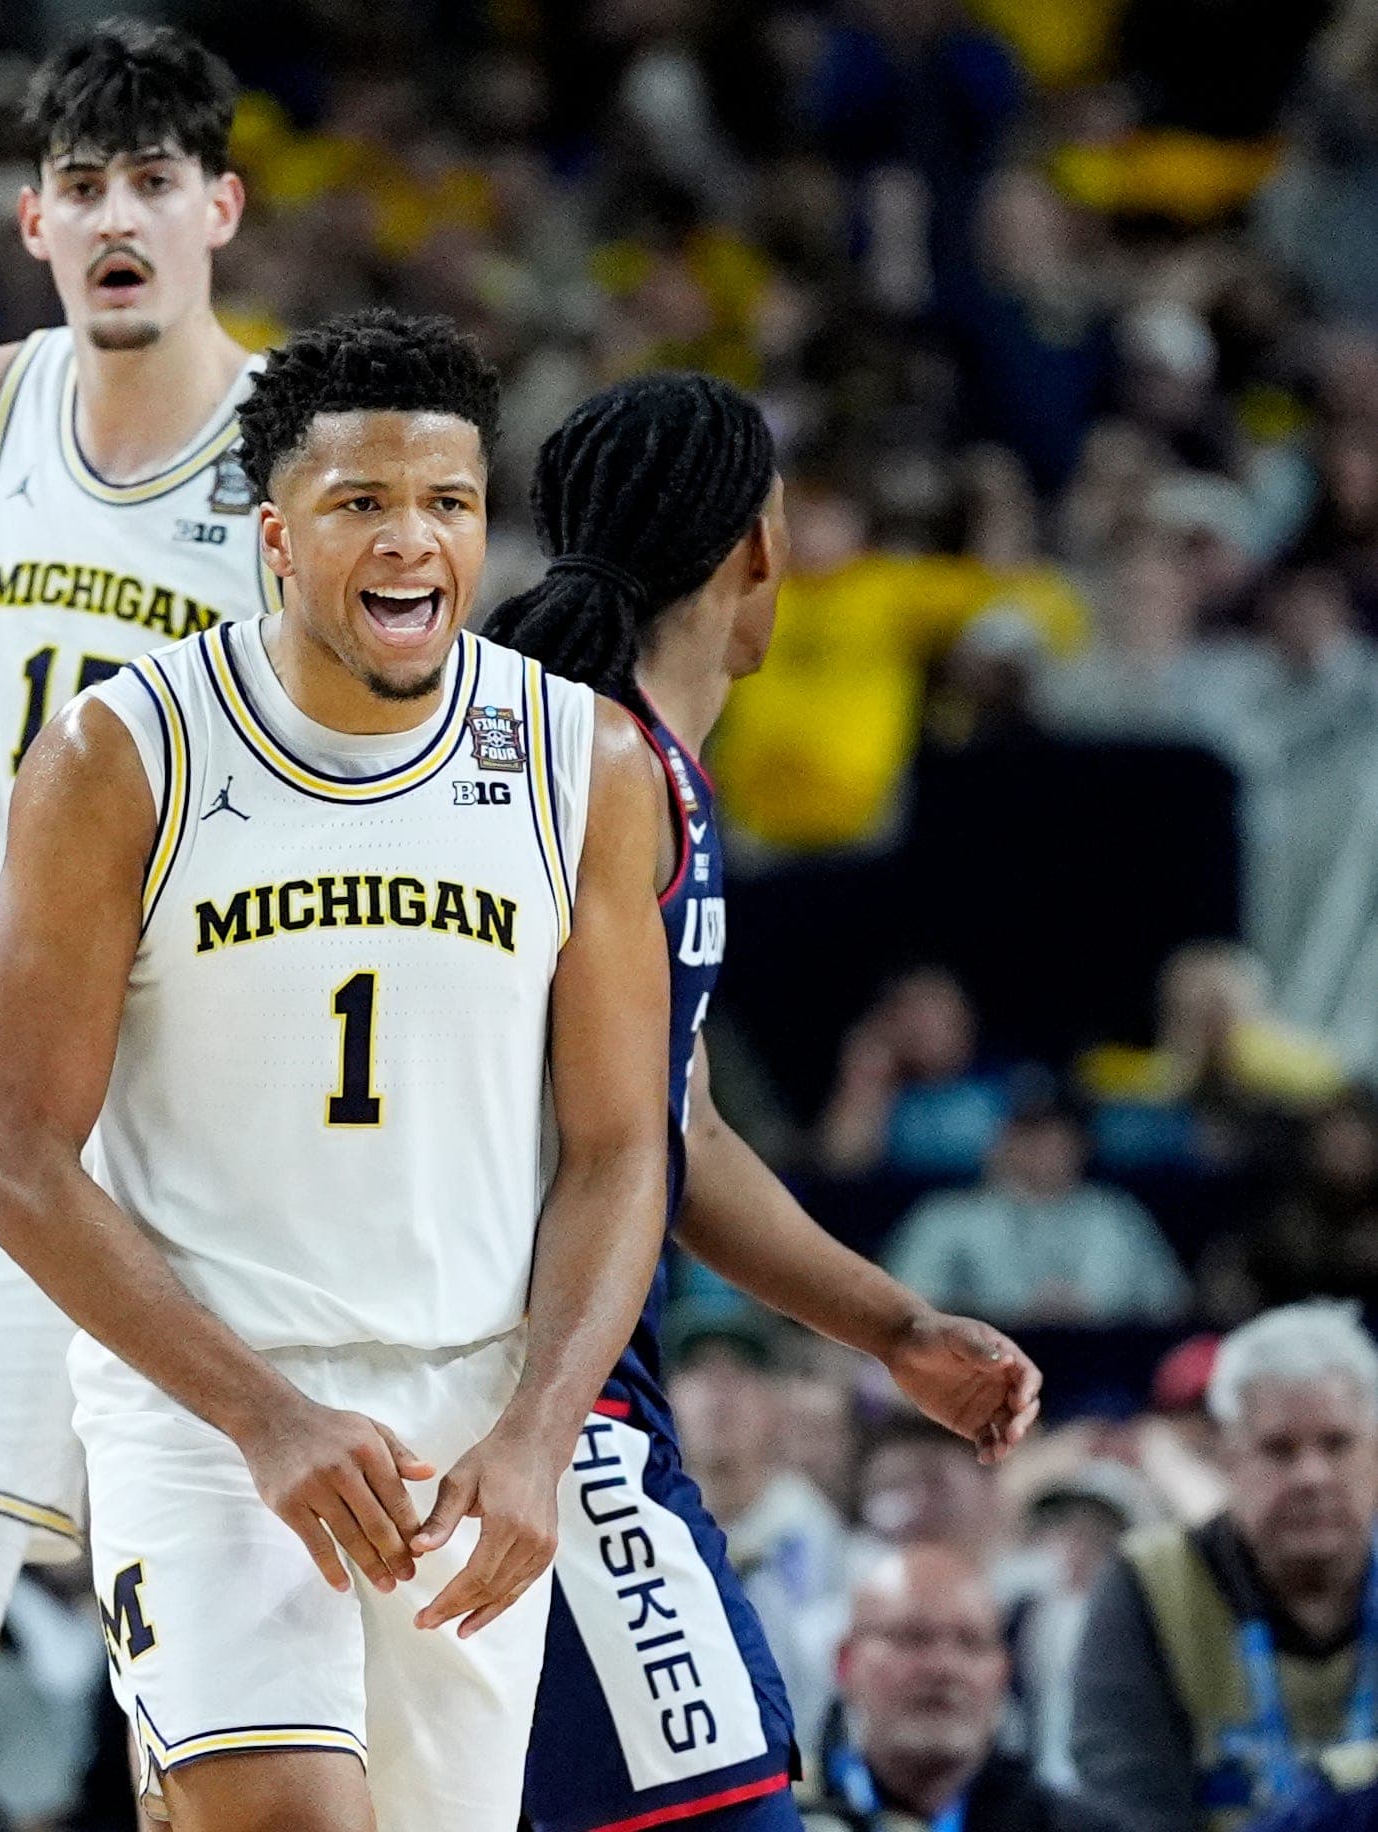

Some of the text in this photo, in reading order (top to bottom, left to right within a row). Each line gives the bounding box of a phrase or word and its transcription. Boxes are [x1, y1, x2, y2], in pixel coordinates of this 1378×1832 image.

[472, 718, 514, 734] FINAL
[480, 744, 519, 760] FOUR
[195, 875, 518, 955] MICHIGAN
[325, 970, 385, 1128] 1
[572, 1422, 718, 1755] HUSKIES
